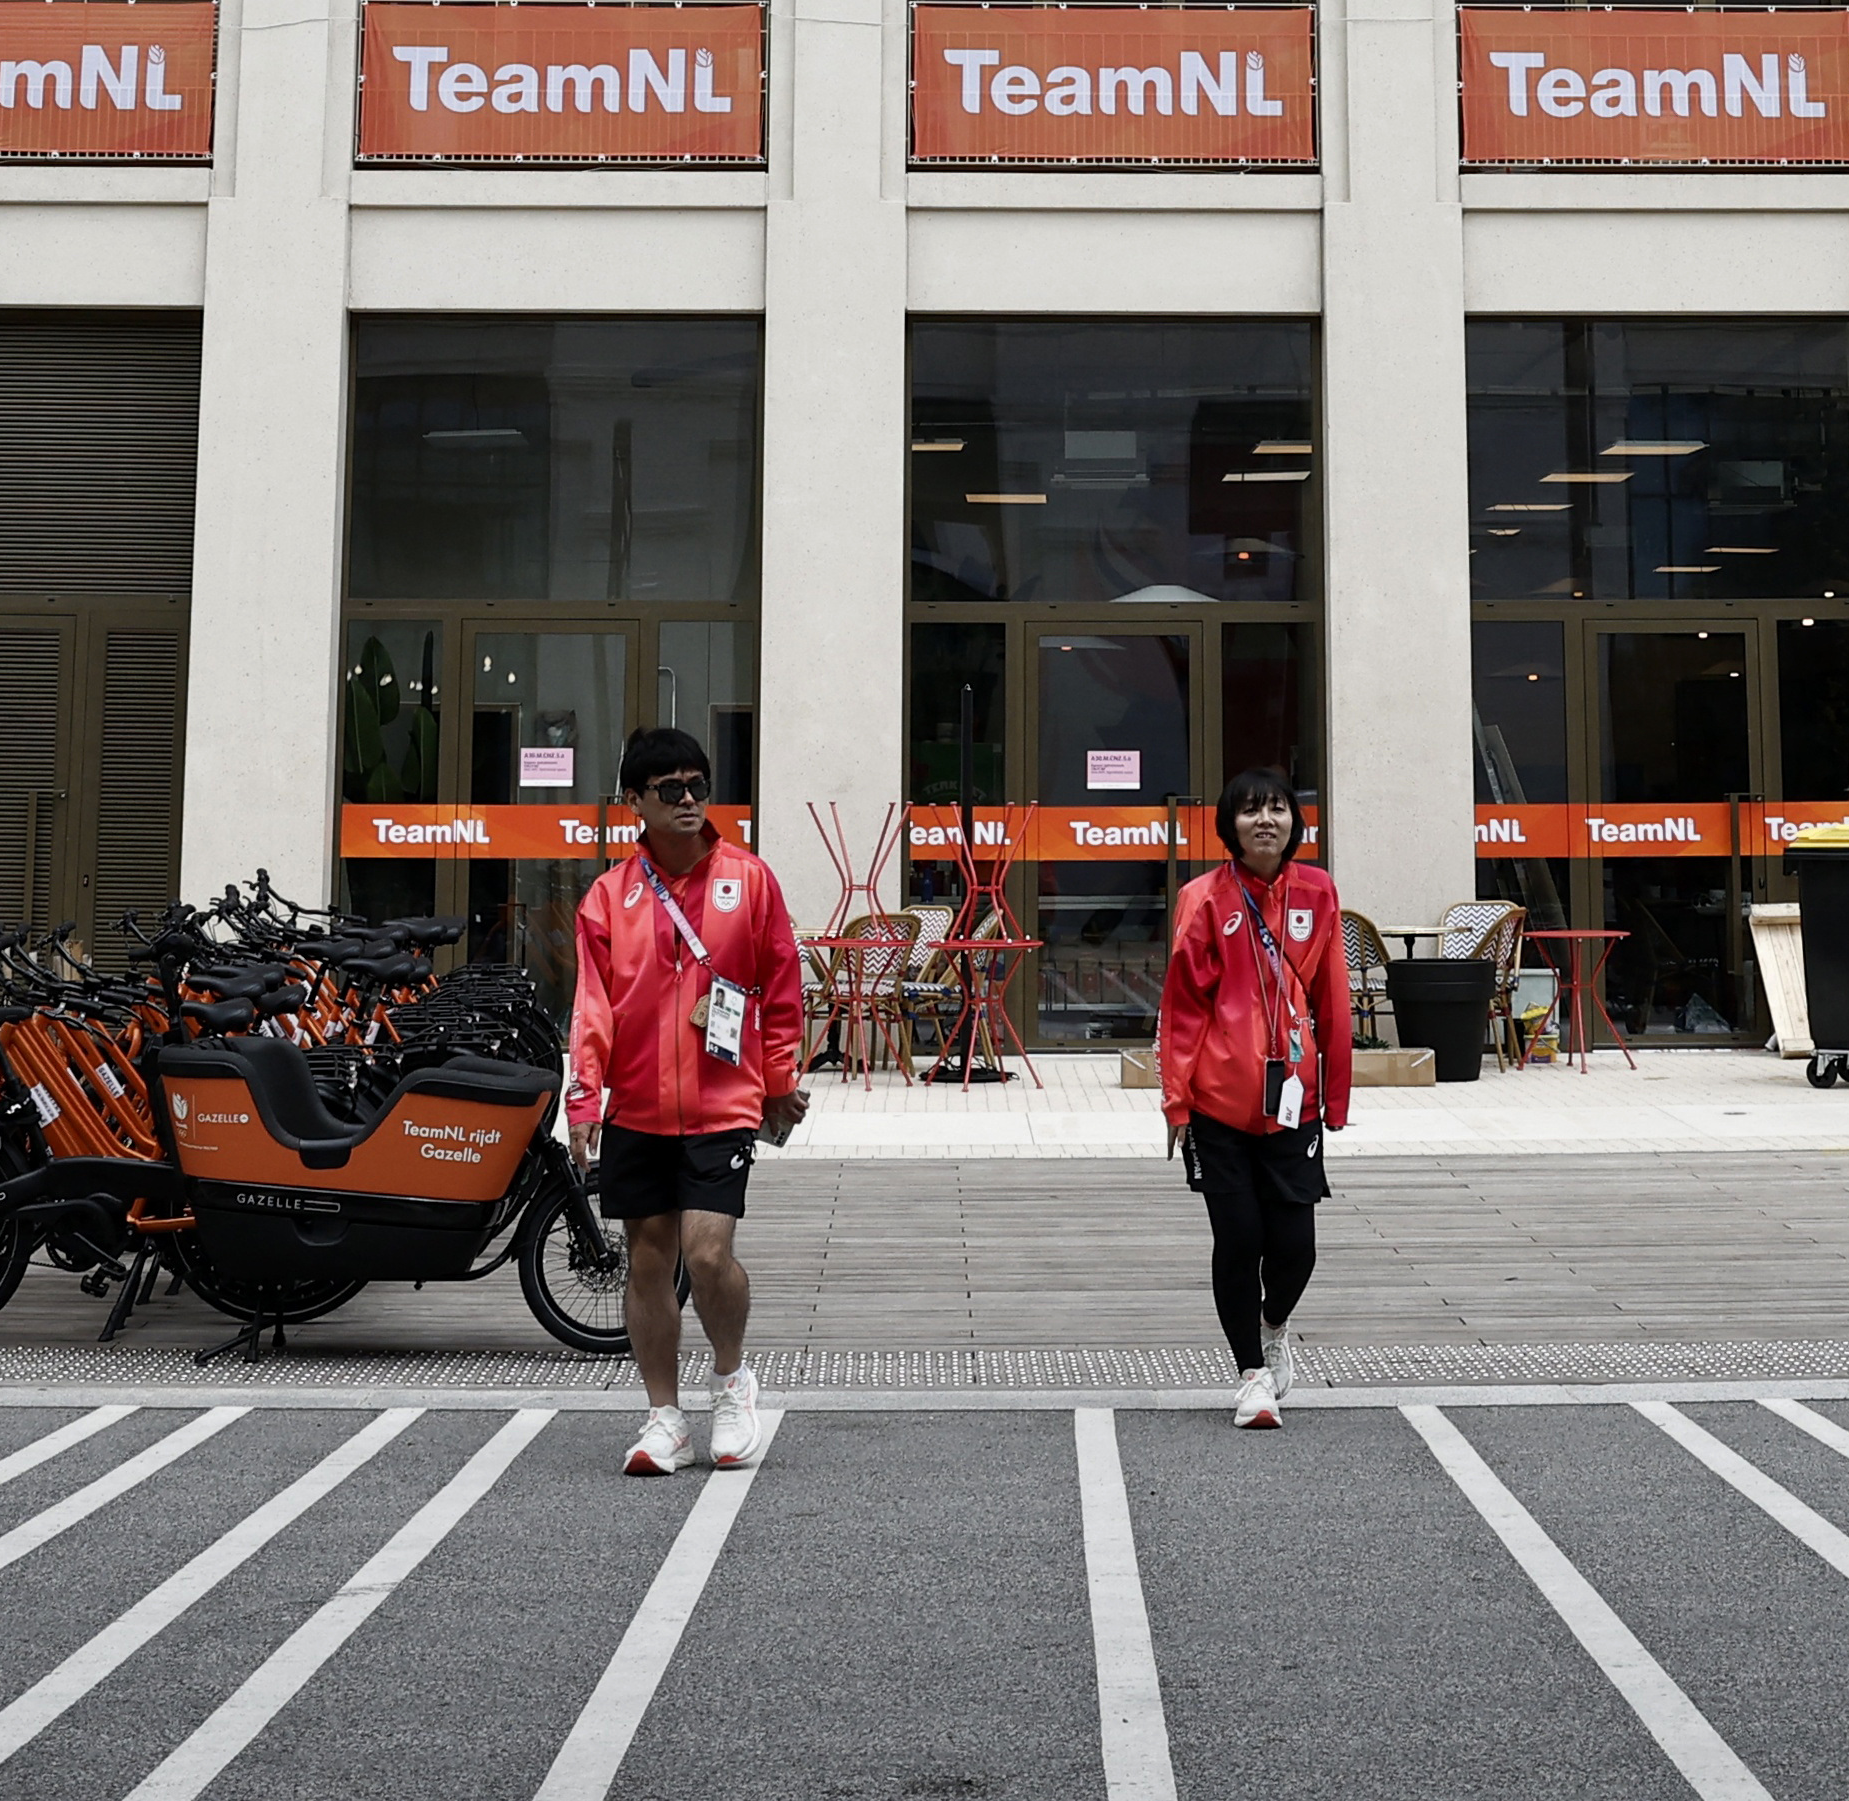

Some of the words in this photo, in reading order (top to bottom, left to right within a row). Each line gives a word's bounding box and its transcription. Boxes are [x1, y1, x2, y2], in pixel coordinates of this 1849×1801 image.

[393, 47, 731, 113] TeamNL
[944, 50, 1282, 115] TeamNL
[1490, 52, 1825, 117] TeamNL
[373, 819, 489, 844] TeamNL
[1585, 818, 1700, 842] TeamNL
[98, 1067, 121, 1098] GAZELLE
[197, 1113, 240, 1123] GAZELLE
[403, 1120, 466, 1142] TeamNL
[469, 1129, 502, 1148] rijdt
[420, 1143, 482, 1163] Gazelle
[236, 1193, 301, 1210] GAZELLE
